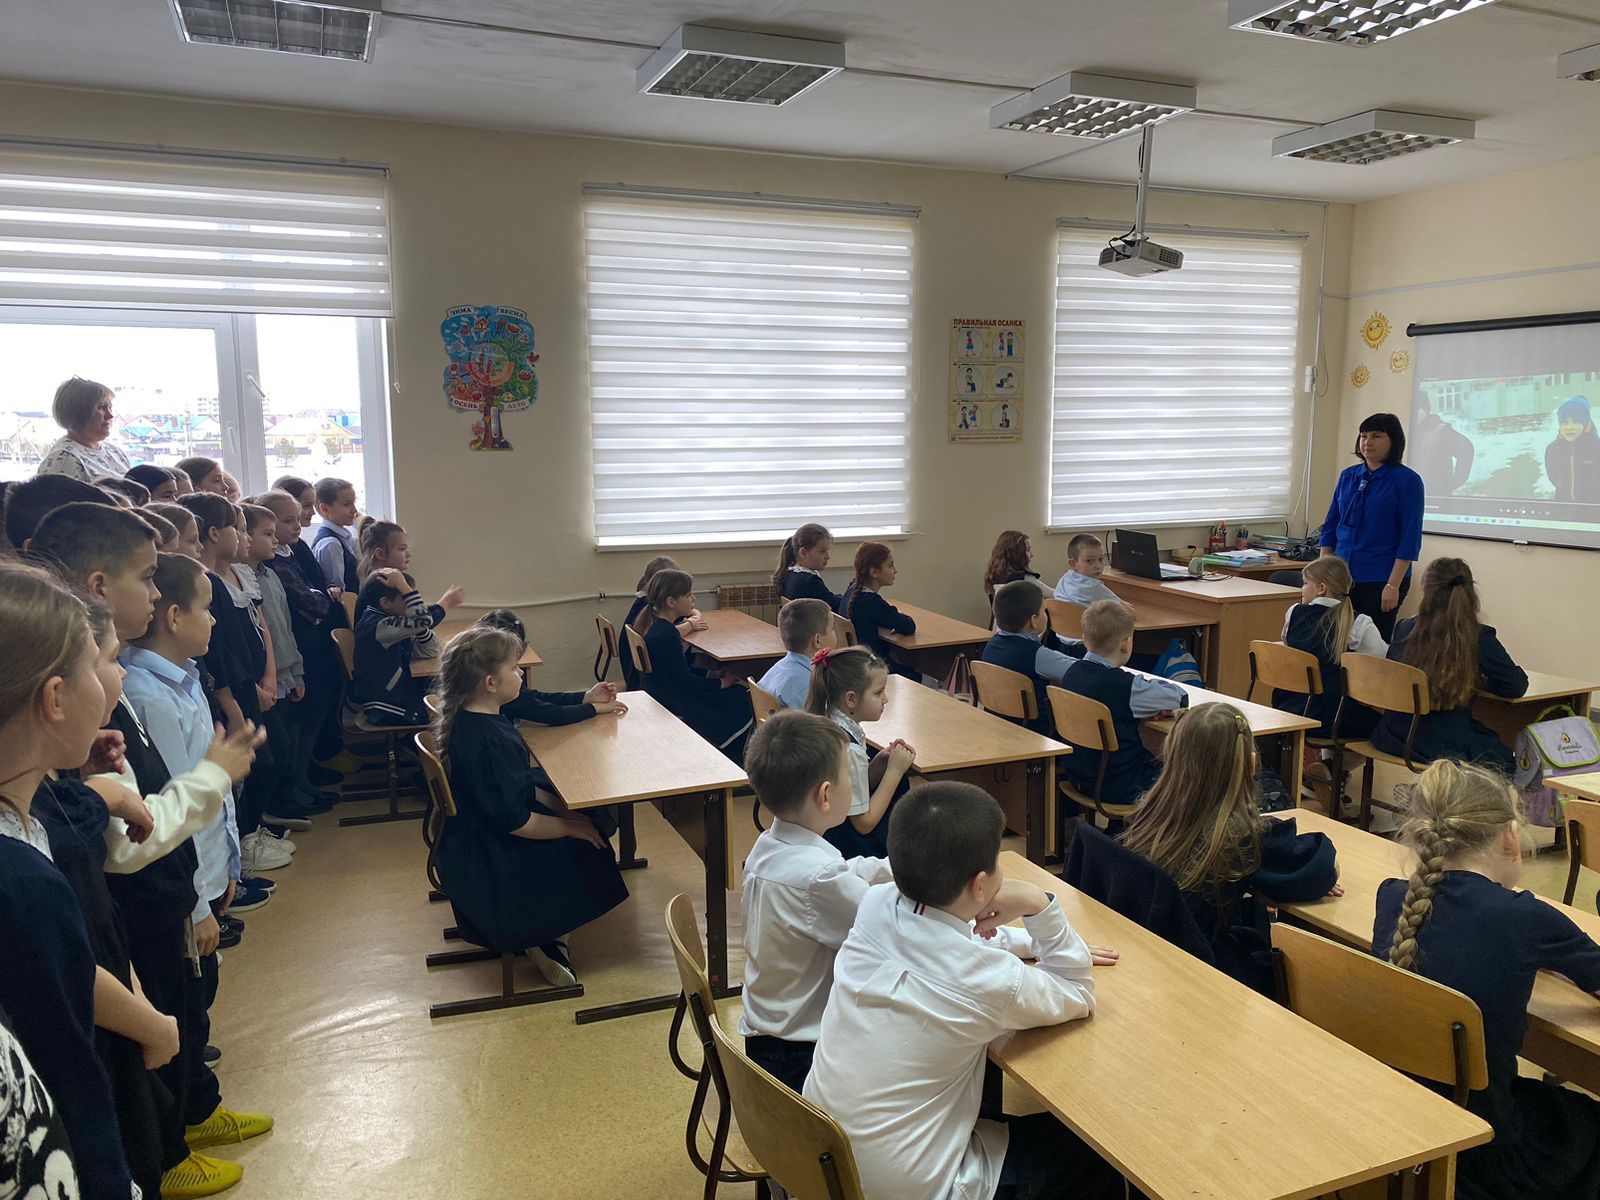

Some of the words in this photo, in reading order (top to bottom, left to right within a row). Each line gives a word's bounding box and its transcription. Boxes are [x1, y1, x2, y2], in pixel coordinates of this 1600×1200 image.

[450, 308, 472, 316] ЗИМА
[500, 308, 524, 318] ВЕСНА
[454, 401, 478, 409] ОСЕНЬ
[508, 401, 526, 409] ЛЕТО
